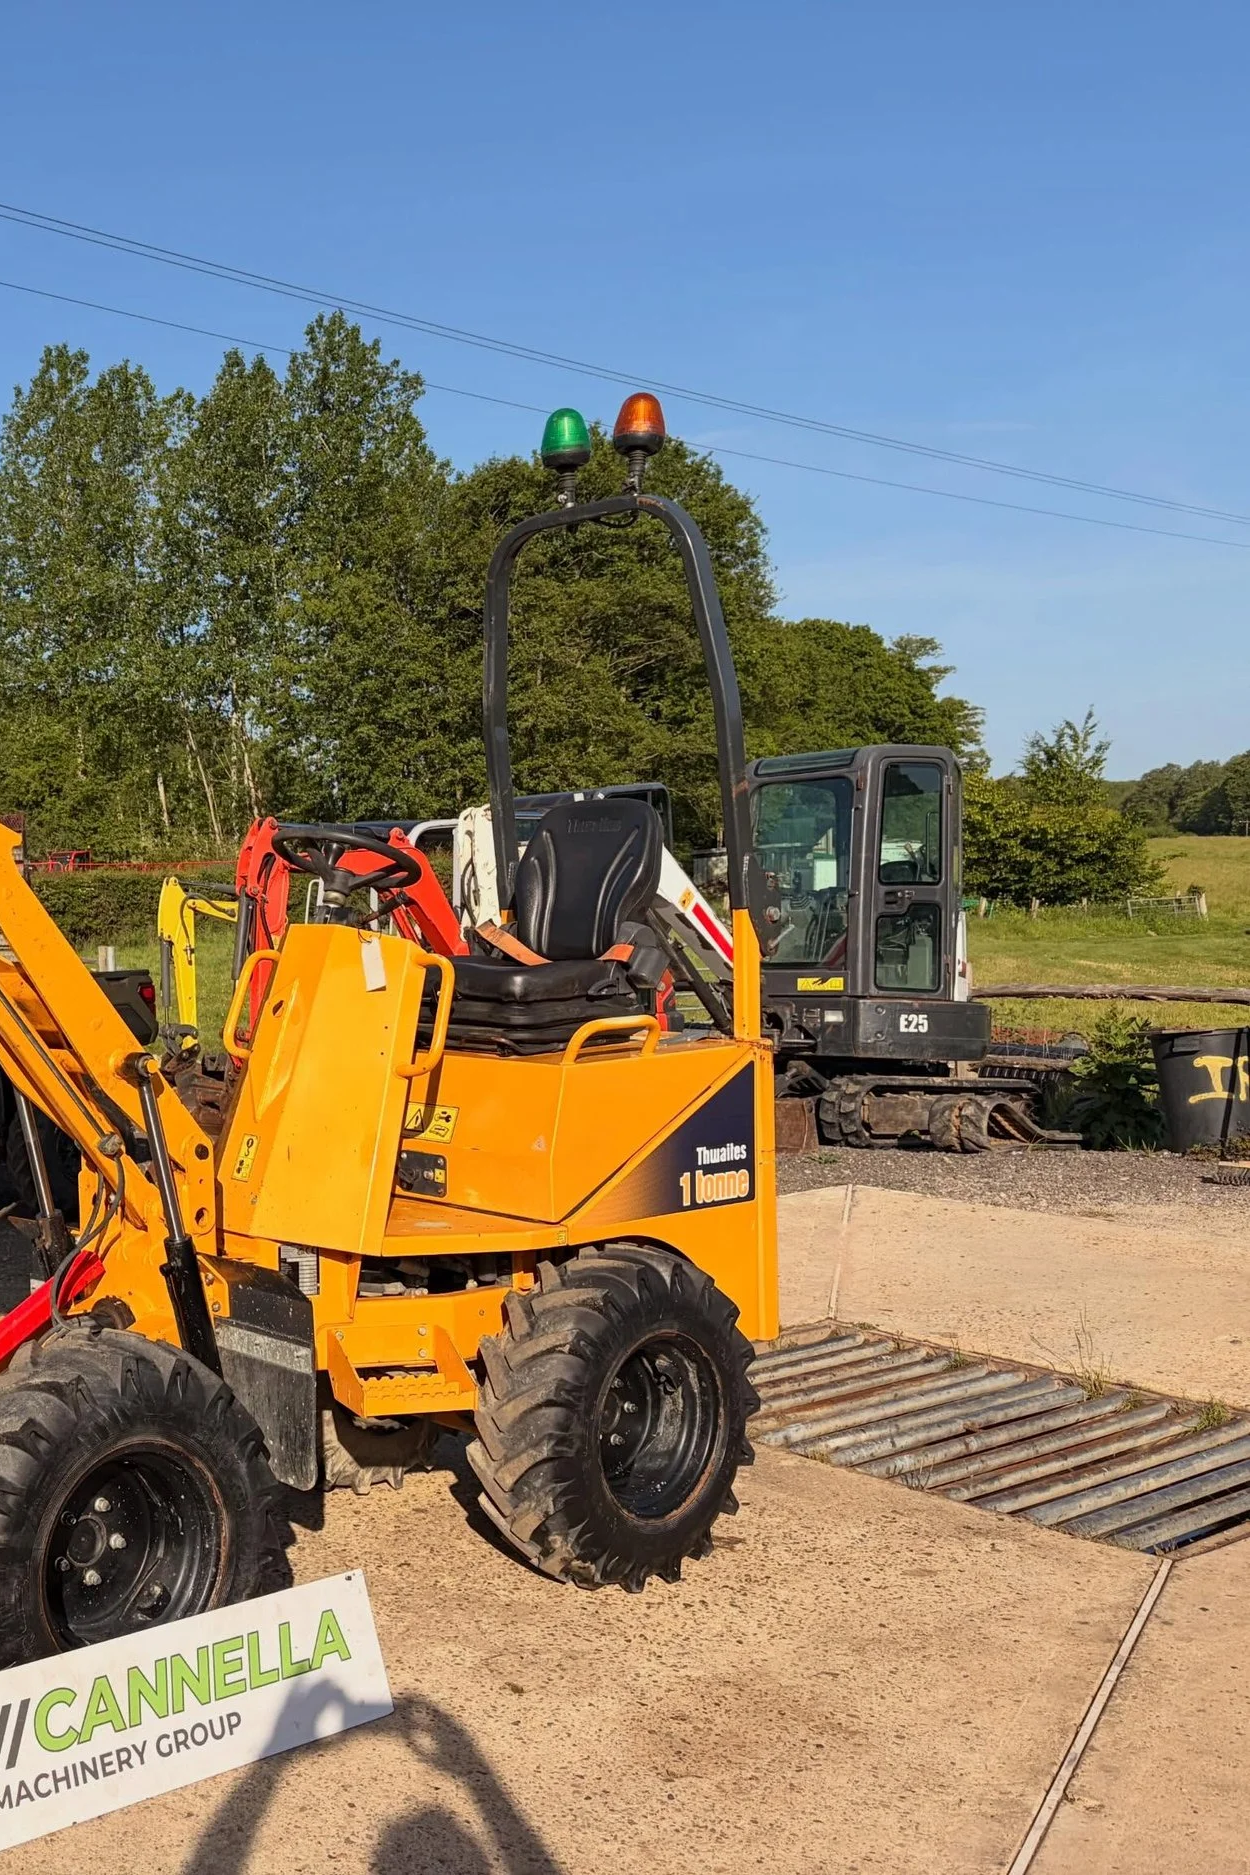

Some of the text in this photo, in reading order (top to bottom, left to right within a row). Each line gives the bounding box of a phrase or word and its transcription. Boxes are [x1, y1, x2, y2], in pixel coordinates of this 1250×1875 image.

[899, 1013, 929, 1034] E25
[695, 1143, 747, 1166] Thwaites
[679, 1169, 750, 1207] 1 tonne
[33, 1608, 352, 1752] CANNELLA
[154, 1711, 243, 1760] GROUP
